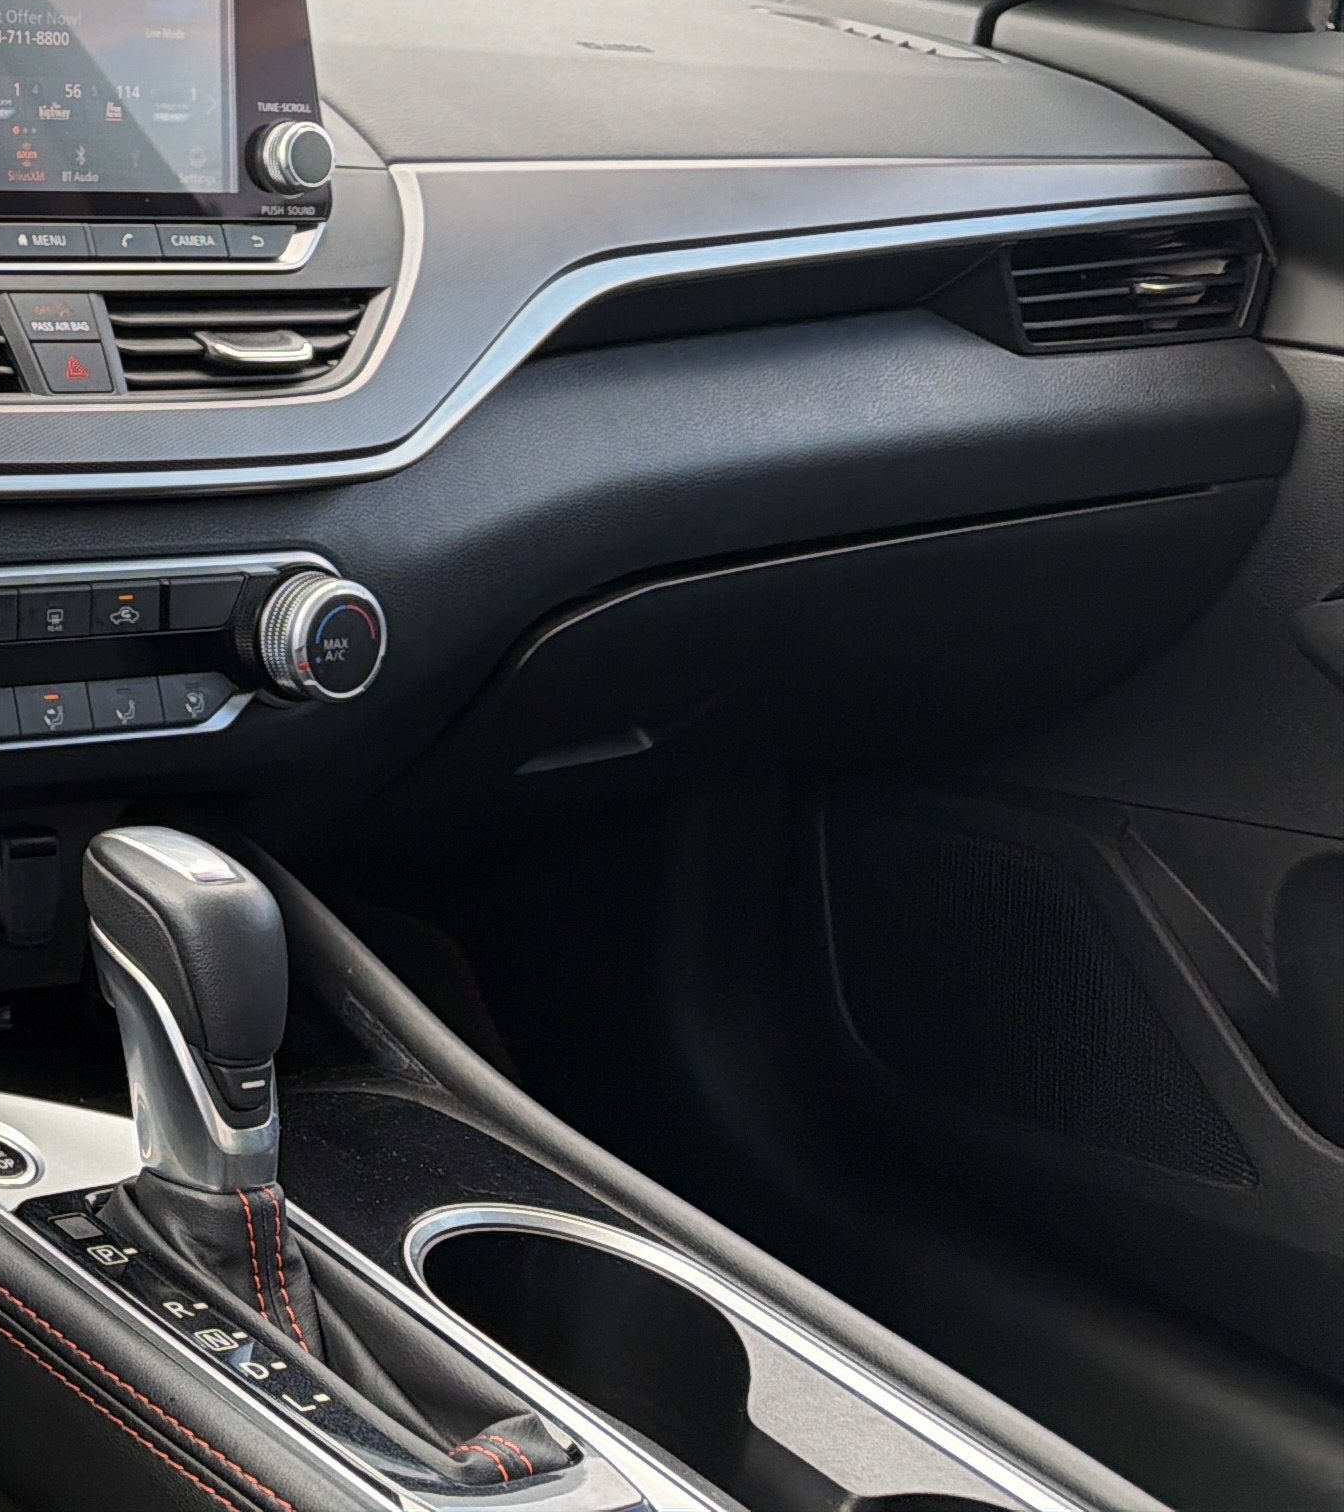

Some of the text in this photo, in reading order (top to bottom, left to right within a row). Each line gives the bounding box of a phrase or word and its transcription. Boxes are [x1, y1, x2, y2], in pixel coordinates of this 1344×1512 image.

[5, 8, 43, 25] Offer
[46, 10, 83, 27] Now!
[14, 82, 21, 97] 1
[64, 84, 82, 99] 56
[116, 86, 141, 100] 114
[8, 170, 46, 182] SiriusXM
[62, 172, 99, 183] BT Audio
[261, 206, 285, 216] PUSH
[32, 235, 67, 247] MENU
[171, 235, 215, 247] CAMERA
[31, 321, 54, 332] PASS
[323, 638, 349, 649] MAX
[325, 649, 346, 662] A/C
[100, 1247, 116, 1263] P
[163, 1300, 197, 1320] R
[204, 1329, 229, 1349] N
[239, 1362, 269, 1380] D
[282, 1394, 318, 1411] L
